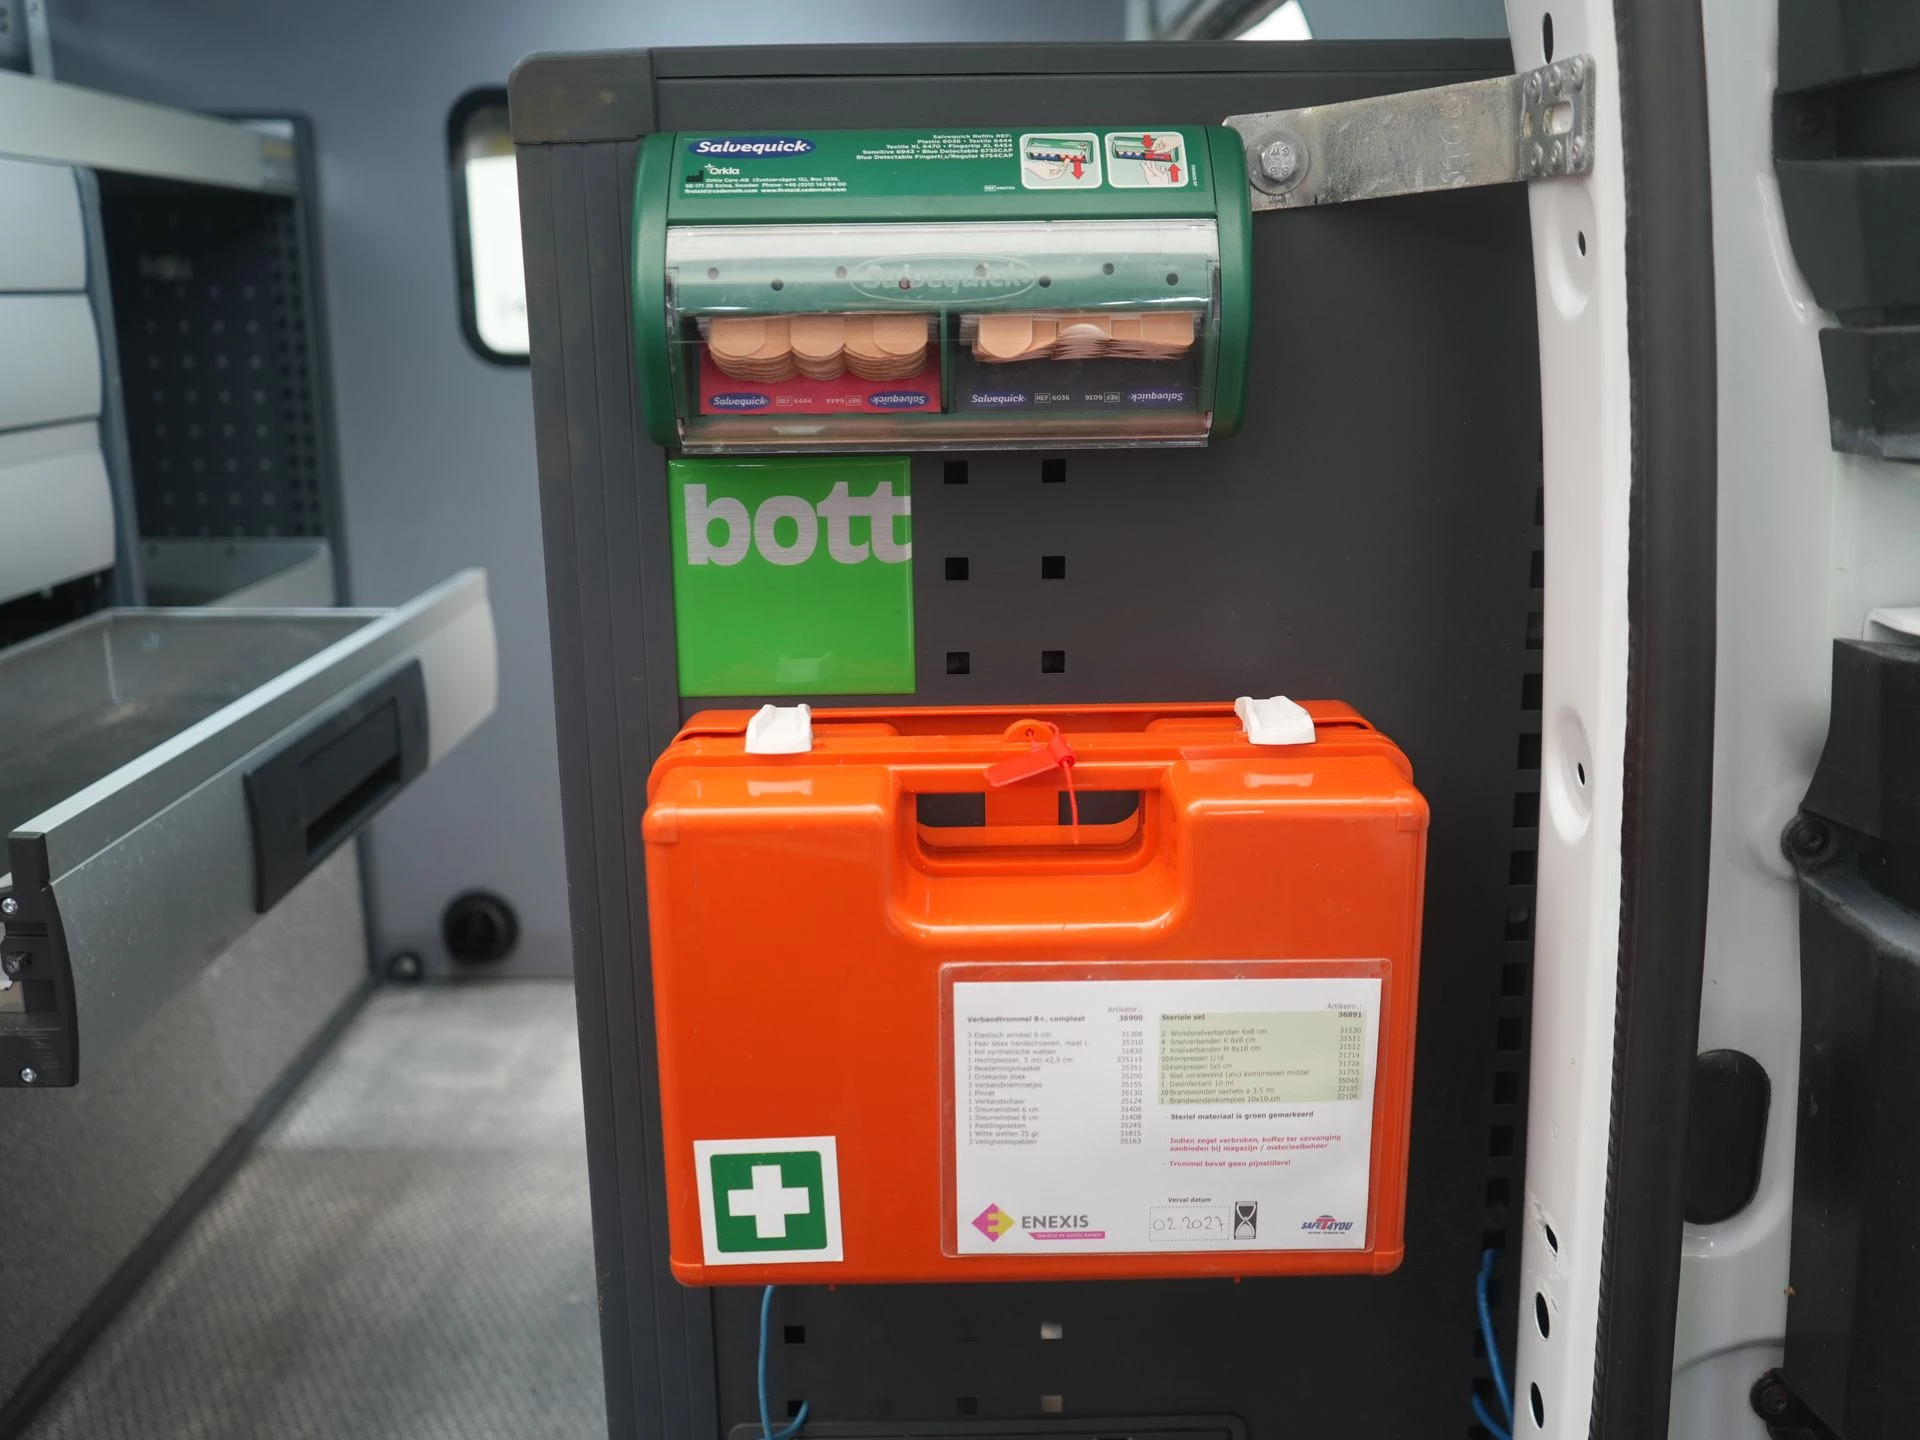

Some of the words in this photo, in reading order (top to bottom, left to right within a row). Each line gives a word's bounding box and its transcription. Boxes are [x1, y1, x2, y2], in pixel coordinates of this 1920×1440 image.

[697, 141, 806, 155] Salvequick
[710, 167, 740, 175] Orkla
[713, 397, 766, 406] Salvequick
[972, 395, 1024, 404] Salvequick
[684, 482, 912, 566] bott
[1050, 1015, 1085, 1023] compleet
[1268, 1111, 1314, 1120] gemarkeerd
[1197, 1137, 1217, 1145] zegel
[1219, 1136, 1260, 1145] verbroken,
[1300, 1134, 1341, 1143] vervanging
[1211, 1145, 1221, 1153] bij
[1223, 1144, 1258, 1152] magazijn
[1248, 1159, 1291, 1168] pijnstillers!
[1022, 1215, 1089, 1228] ENEXIS
